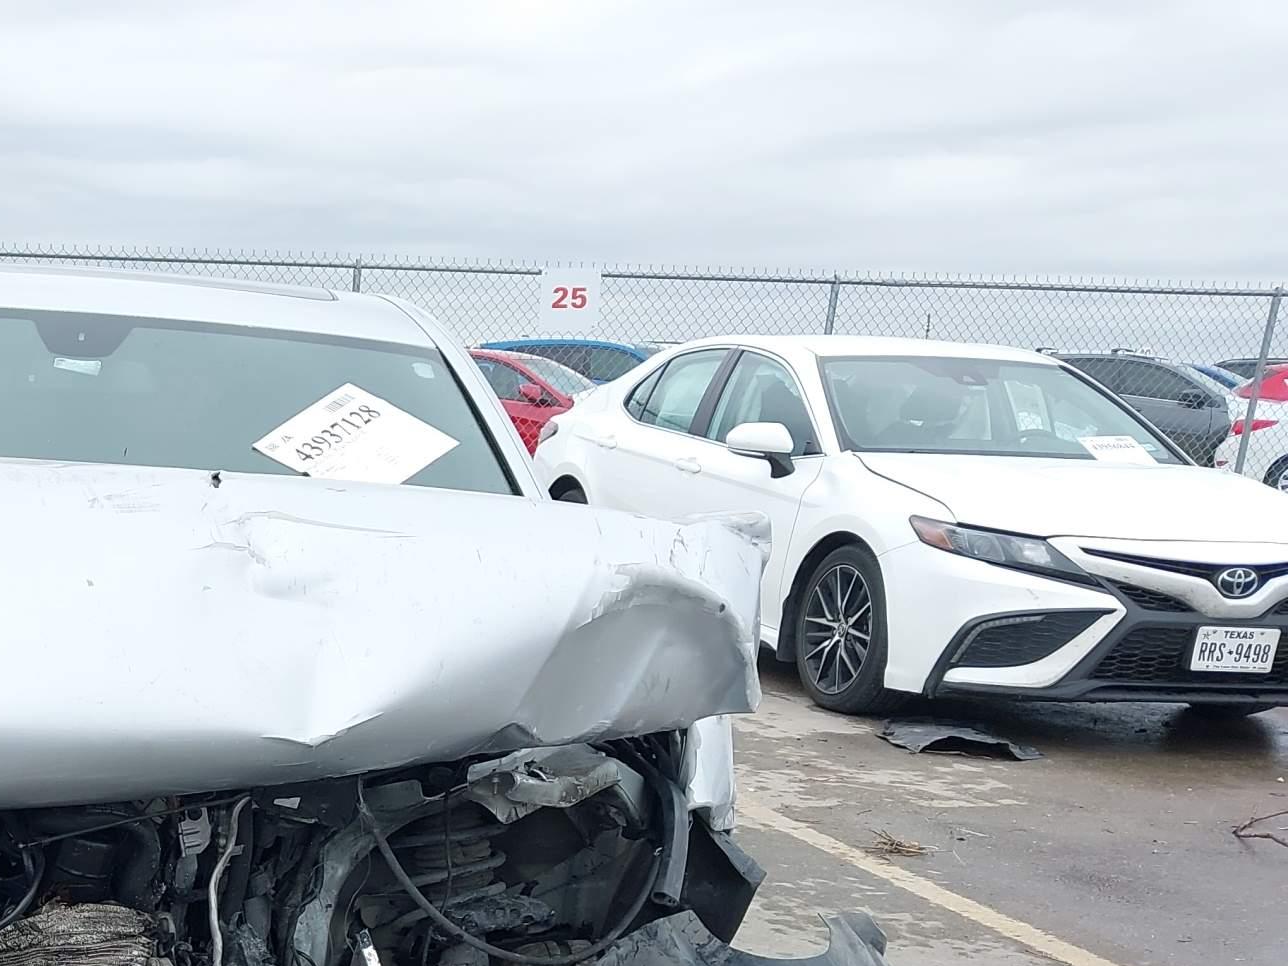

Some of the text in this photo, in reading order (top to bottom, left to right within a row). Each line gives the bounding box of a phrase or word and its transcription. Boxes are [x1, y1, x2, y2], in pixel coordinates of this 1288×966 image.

[551, 286, 588, 309] 25
[295, 404, 381, 461] 43937128
[1223, 630, 1255, 640] TEXAS
